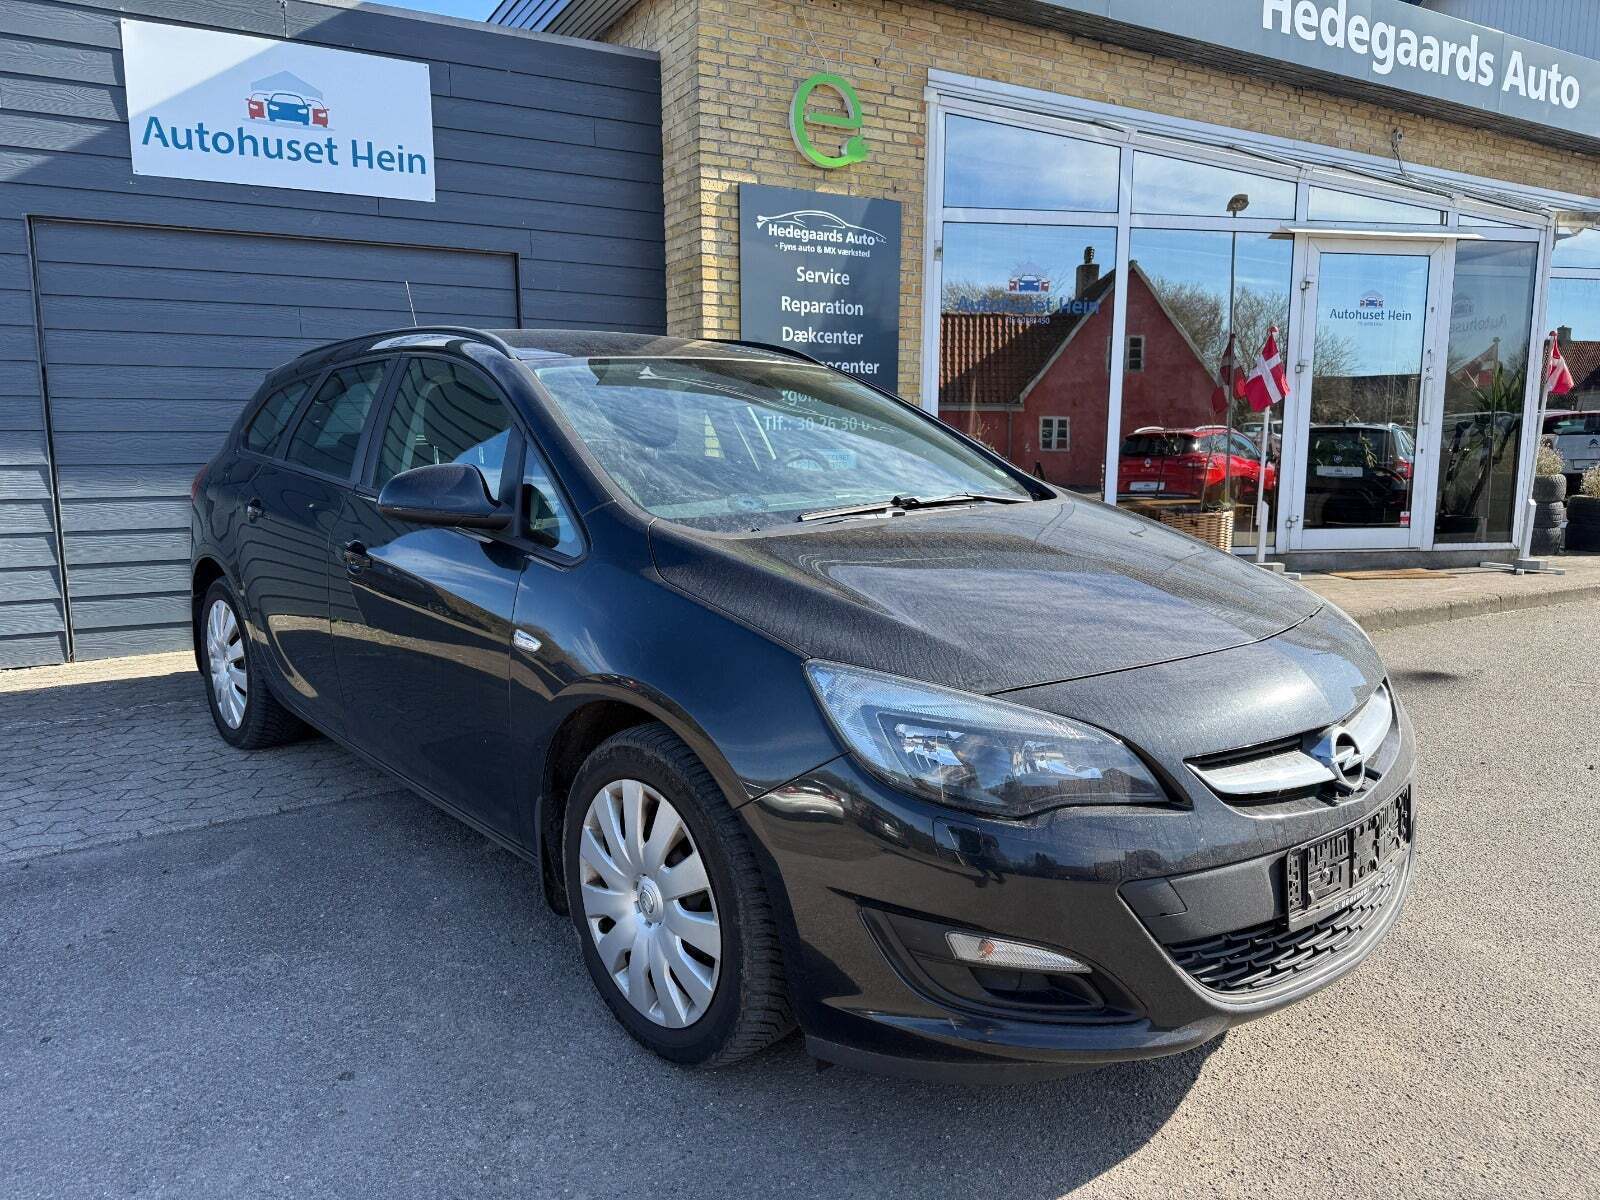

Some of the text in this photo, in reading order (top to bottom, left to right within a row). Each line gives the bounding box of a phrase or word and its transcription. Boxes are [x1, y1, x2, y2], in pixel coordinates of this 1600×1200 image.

[1262, 0, 1580, 109] Hedegaards Auto
[142, 116, 427, 175] Autohuset Hein
[768, 223, 876, 246] Hedegaards Auto
[780, 242, 797, 252] Fyns
[798, 245, 815, 253] auto
[816, 246, 822, 254] &
[824, 246, 836, 255] MX
[837, 248, 870, 258] værksted
[796, 266, 850, 286] Service
[781, 295, 864, 317] Reparation
[1059, 296, 1100, 314] Hein
[1329, 308, 1412, 321] Autohuset Hein
[782, 326, 864, 345] Dækcenter
